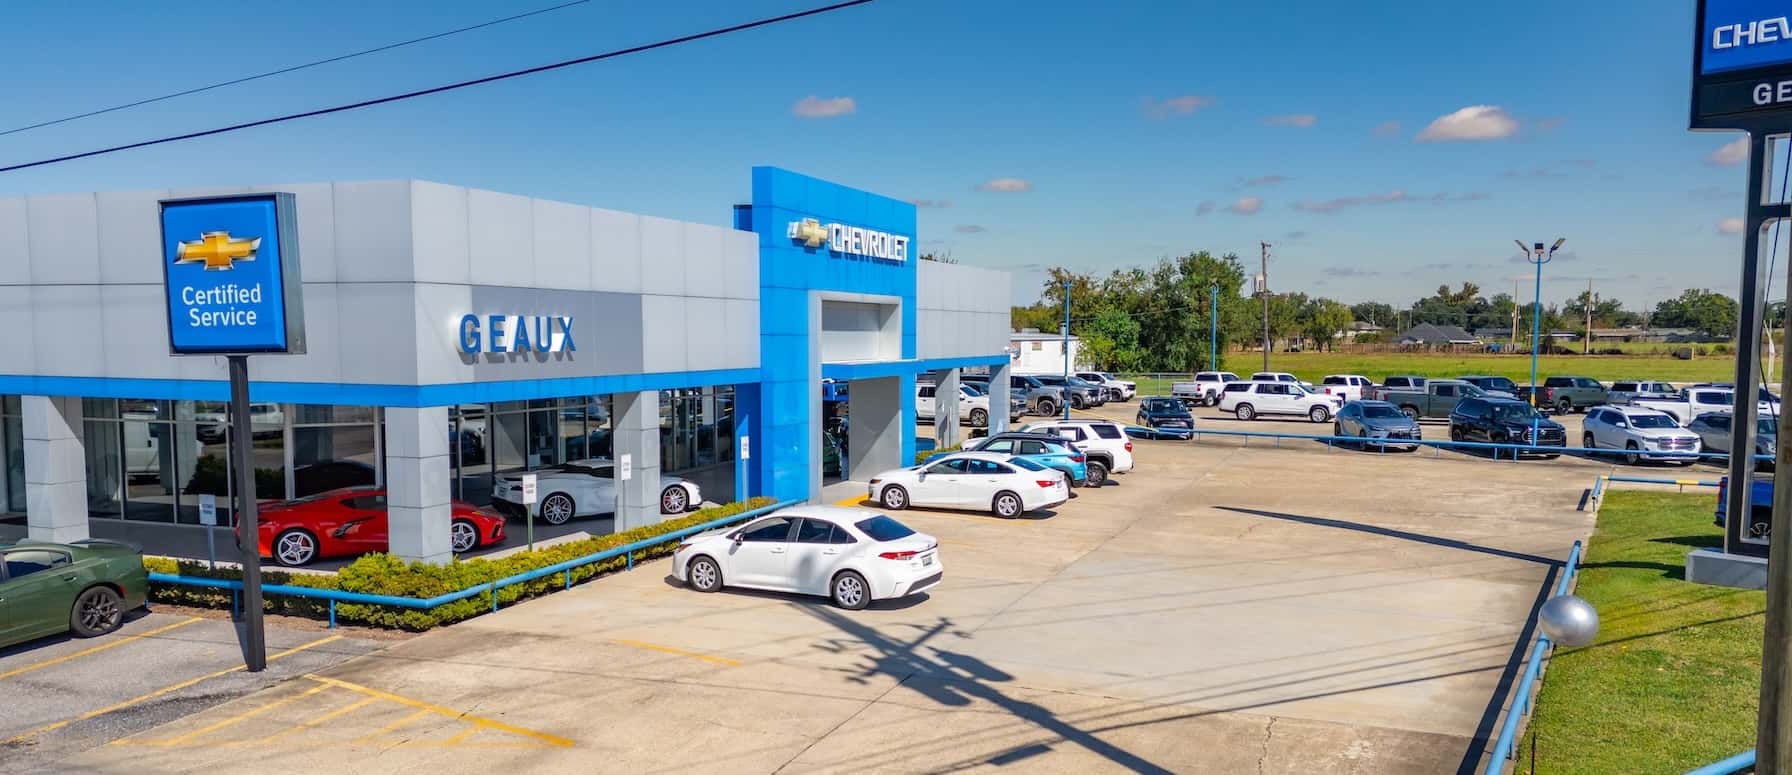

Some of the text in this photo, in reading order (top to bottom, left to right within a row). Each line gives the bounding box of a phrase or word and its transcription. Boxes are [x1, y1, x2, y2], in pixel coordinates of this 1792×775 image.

[1752, 80, 1792, 105] GE
[829, 222, 909, 262] CHEVROLET
[182, 282, 262, 305] Certified
[189, 306, 257, 327] Service
[459, 313, 576, 354] GEAUX
